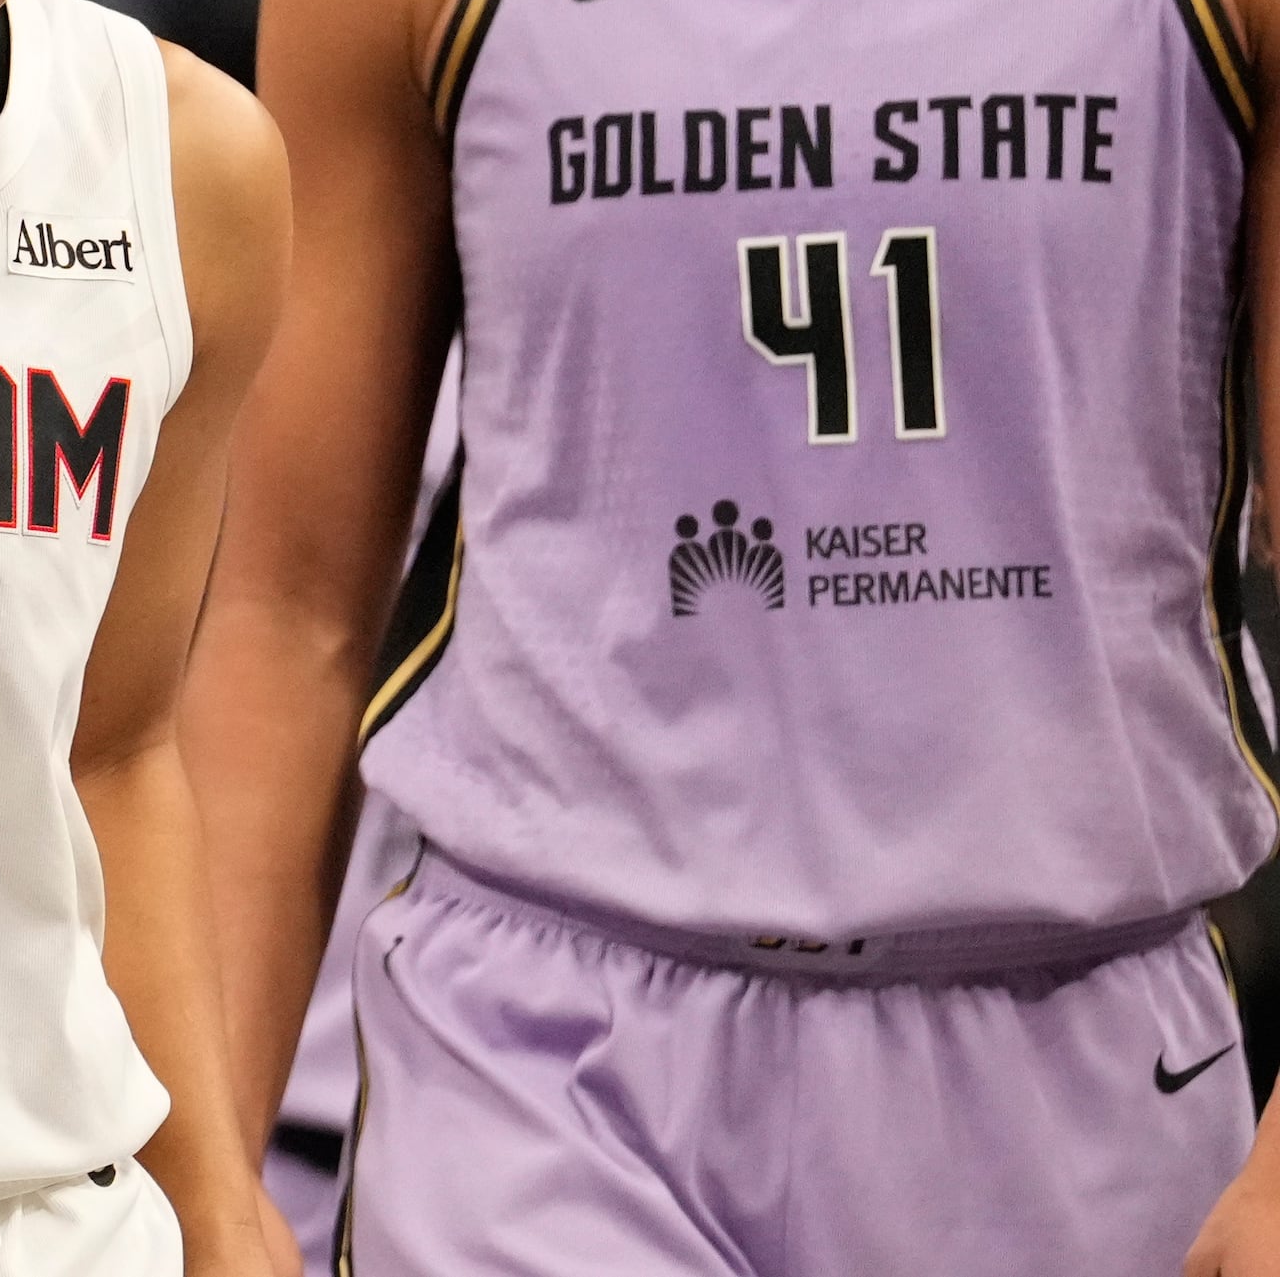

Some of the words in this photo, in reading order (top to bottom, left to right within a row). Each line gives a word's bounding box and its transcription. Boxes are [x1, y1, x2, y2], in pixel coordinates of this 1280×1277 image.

[547, 104, 834, 206] GOLDEN
[872, 94, 1118, 184] STATE
[13, 219, 134, 273] Albert
[740, 227, 945, 444] 41
[805, 525, 927, 558] KAISER
[808, 567, 1053, 607] PERMANENTE
